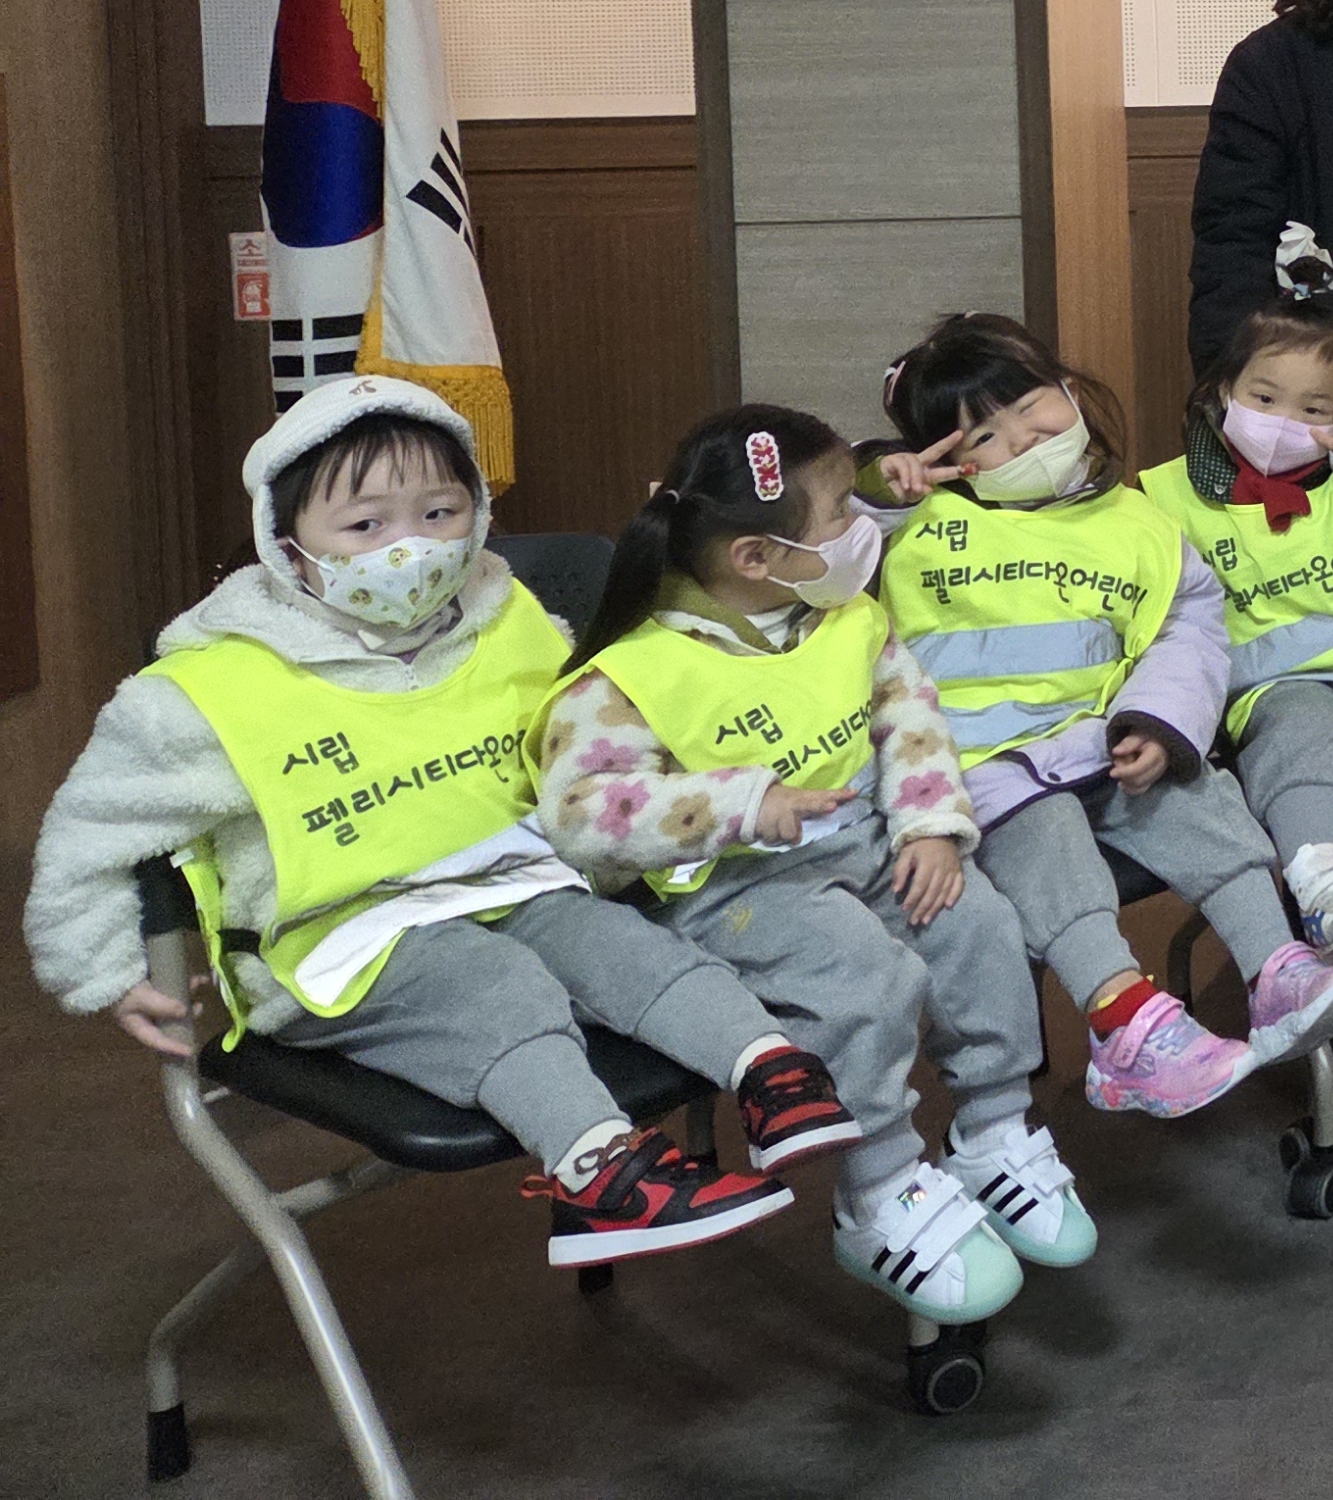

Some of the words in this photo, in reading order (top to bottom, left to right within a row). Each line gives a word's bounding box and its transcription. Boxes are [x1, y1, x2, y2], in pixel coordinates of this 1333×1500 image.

[916, 520, 968, 551] 시립
[715, 704, 784, 745] 시립
[282, 732, 360, 775] 시립
